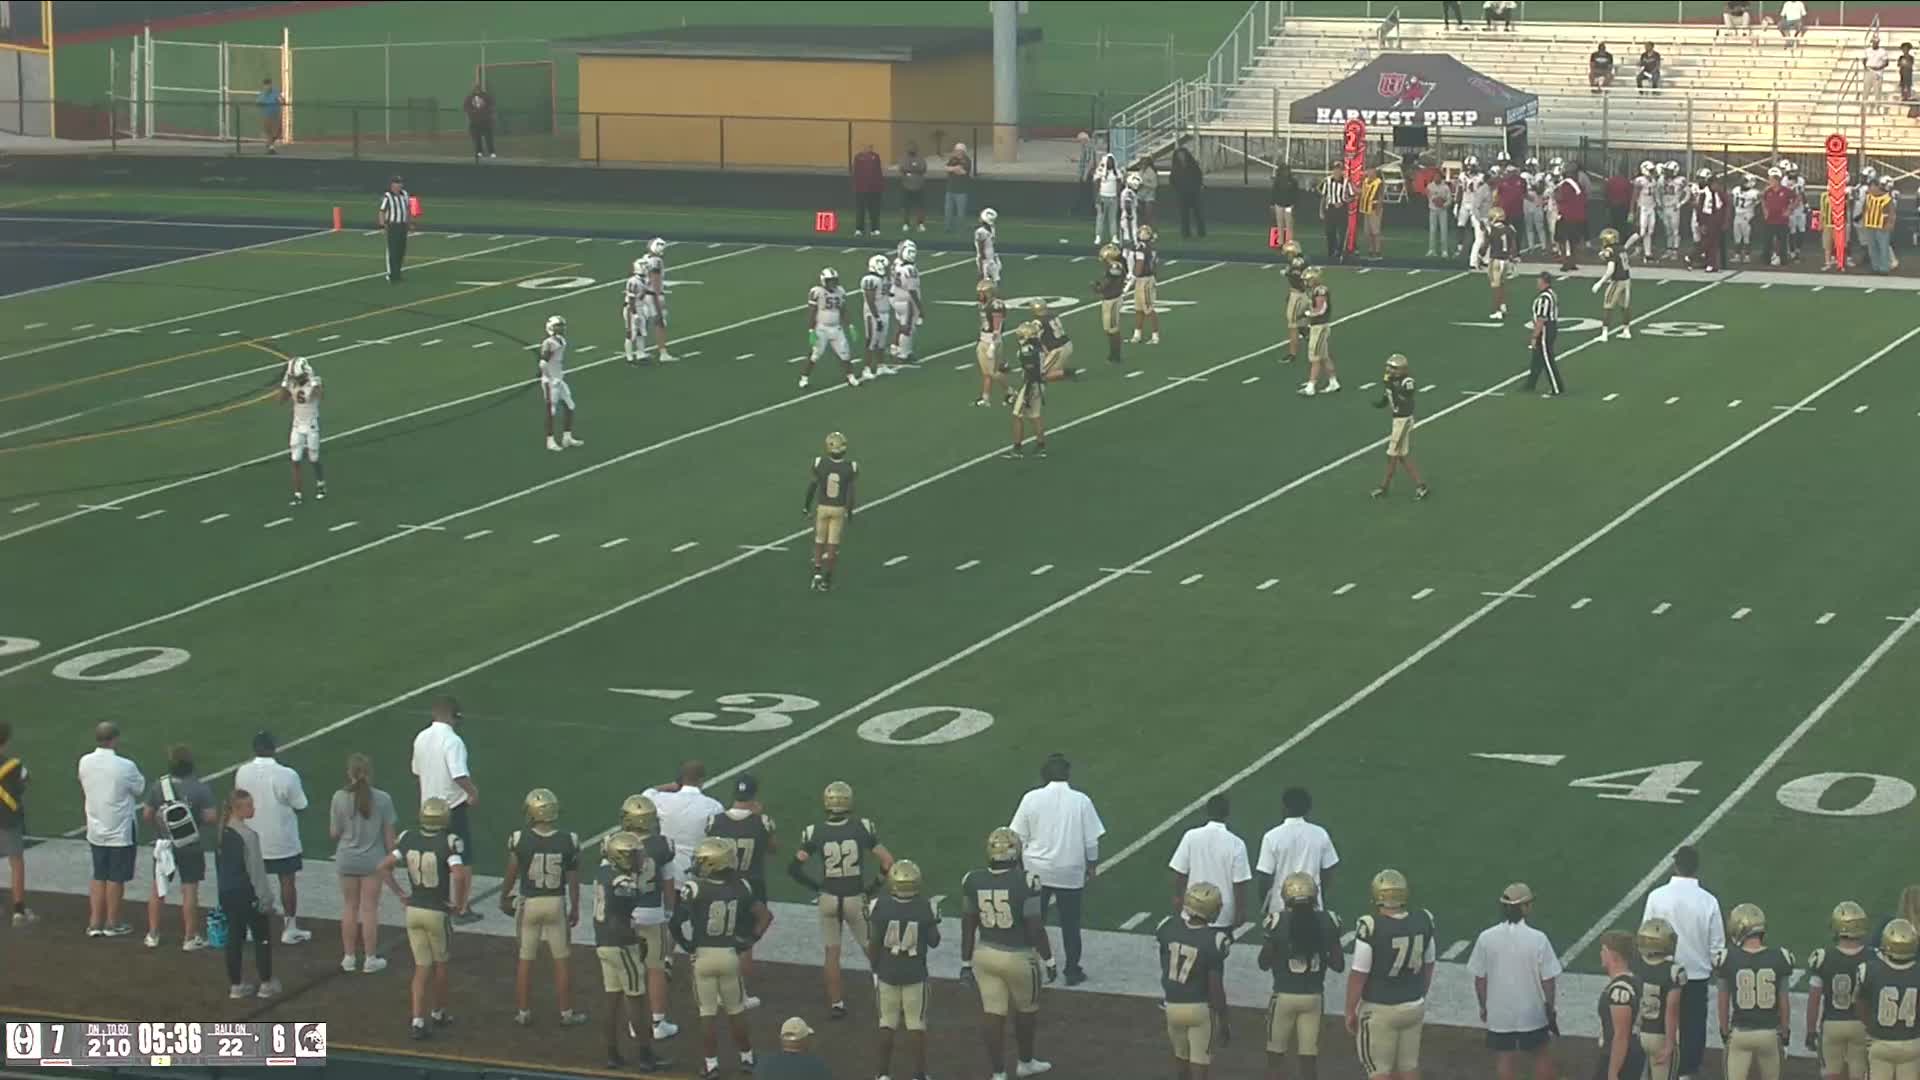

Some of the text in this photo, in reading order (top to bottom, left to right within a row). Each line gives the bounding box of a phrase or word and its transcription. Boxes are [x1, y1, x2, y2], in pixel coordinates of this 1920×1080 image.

[1316, 107, 1479, 126] HARVEST PREP
[296, 390, 306, 405] 6
[826, 472, 841, 499] 6
[528, 852, 563, 889] 45
[824, 839, 861, 878] 22
[977, 889, 1014, 929] 55
[883, 919, 919, 957] 44
[1388, 933, 1425, 977] 74
[1168, 942, 1198, 985] 17
[1610, 987, 1631, 1004] 40
[1735, 968, 1777, 1010] 86
[1878, 986, 1918, 1027] 64
